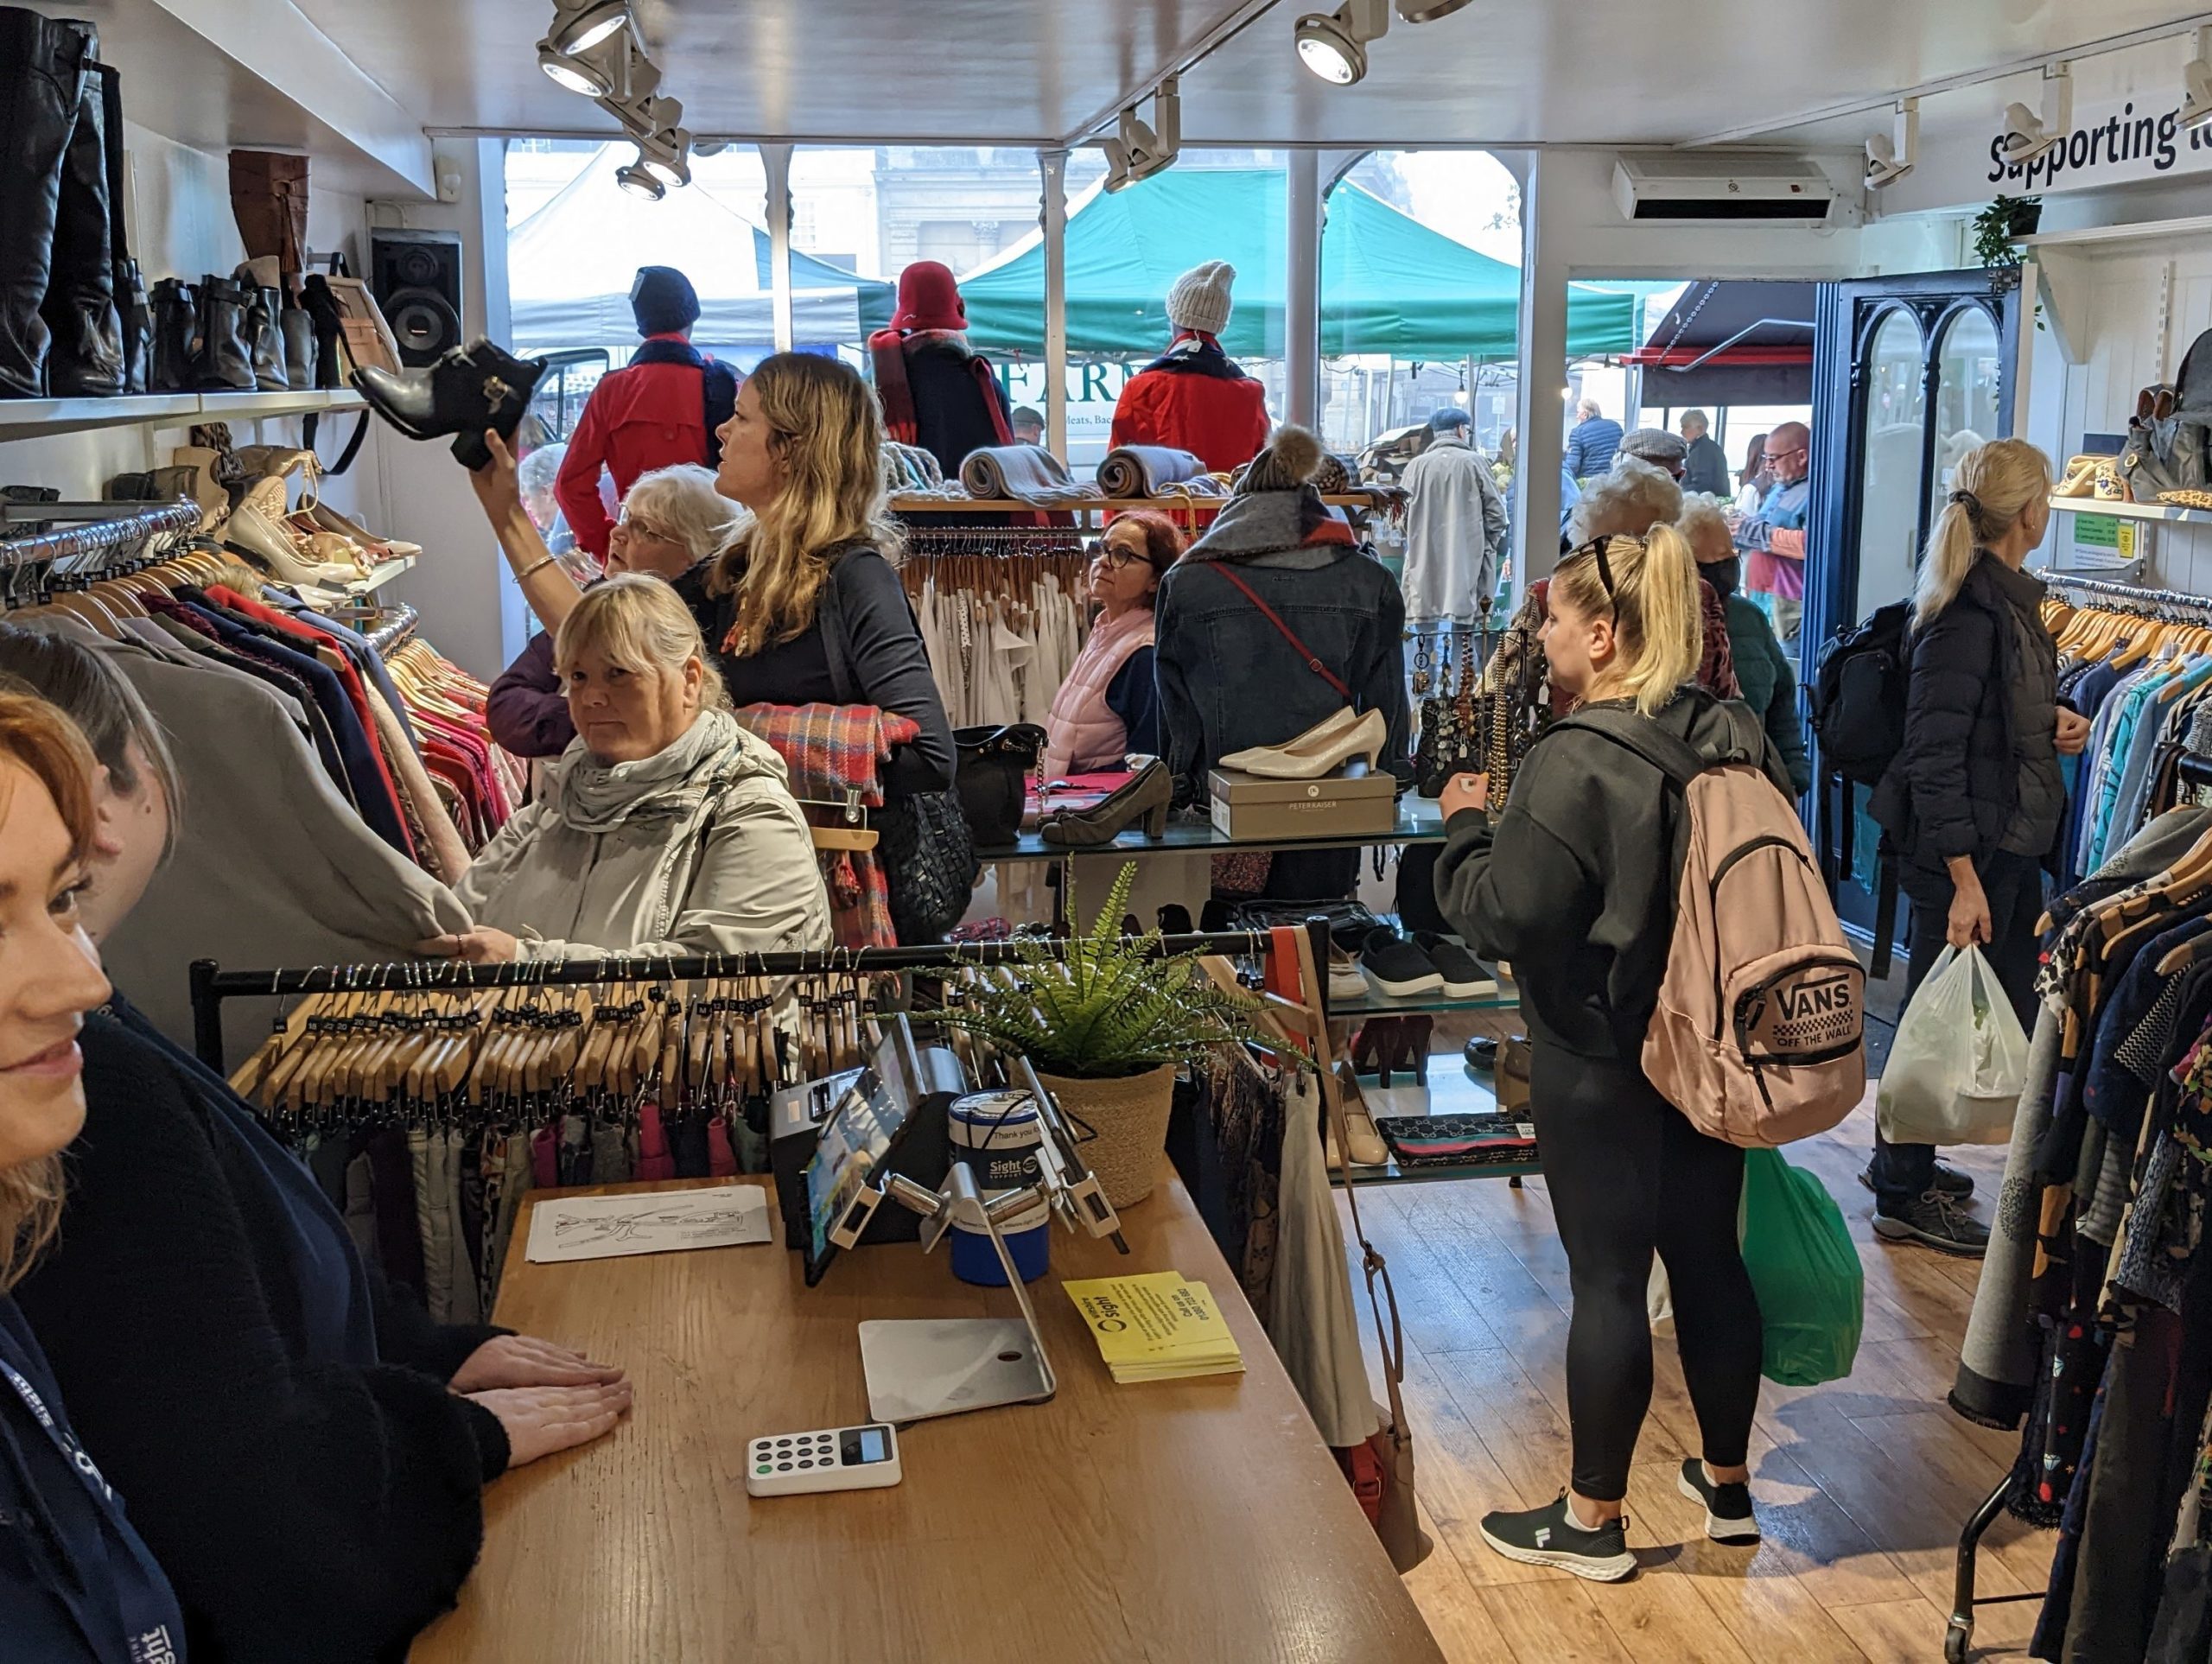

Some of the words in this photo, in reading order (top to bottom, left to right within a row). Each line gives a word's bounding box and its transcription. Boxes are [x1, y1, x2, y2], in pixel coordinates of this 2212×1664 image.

[1000, 363, 1135, 403] FR
[1066, 415, 1092, 425] eats,
[1095, 415, 1111, 424] Bac
[1775, 973, 1849, 1020] VANS
[1804, 1033, 1822, 1045] THE
[994, 1130, 1018, 1140] Thank
[1020, 1128, 1032, 1139] you
[989, 1159, 1021, 1175] Sight
[1093, 1296, 1120, 1318] sight
